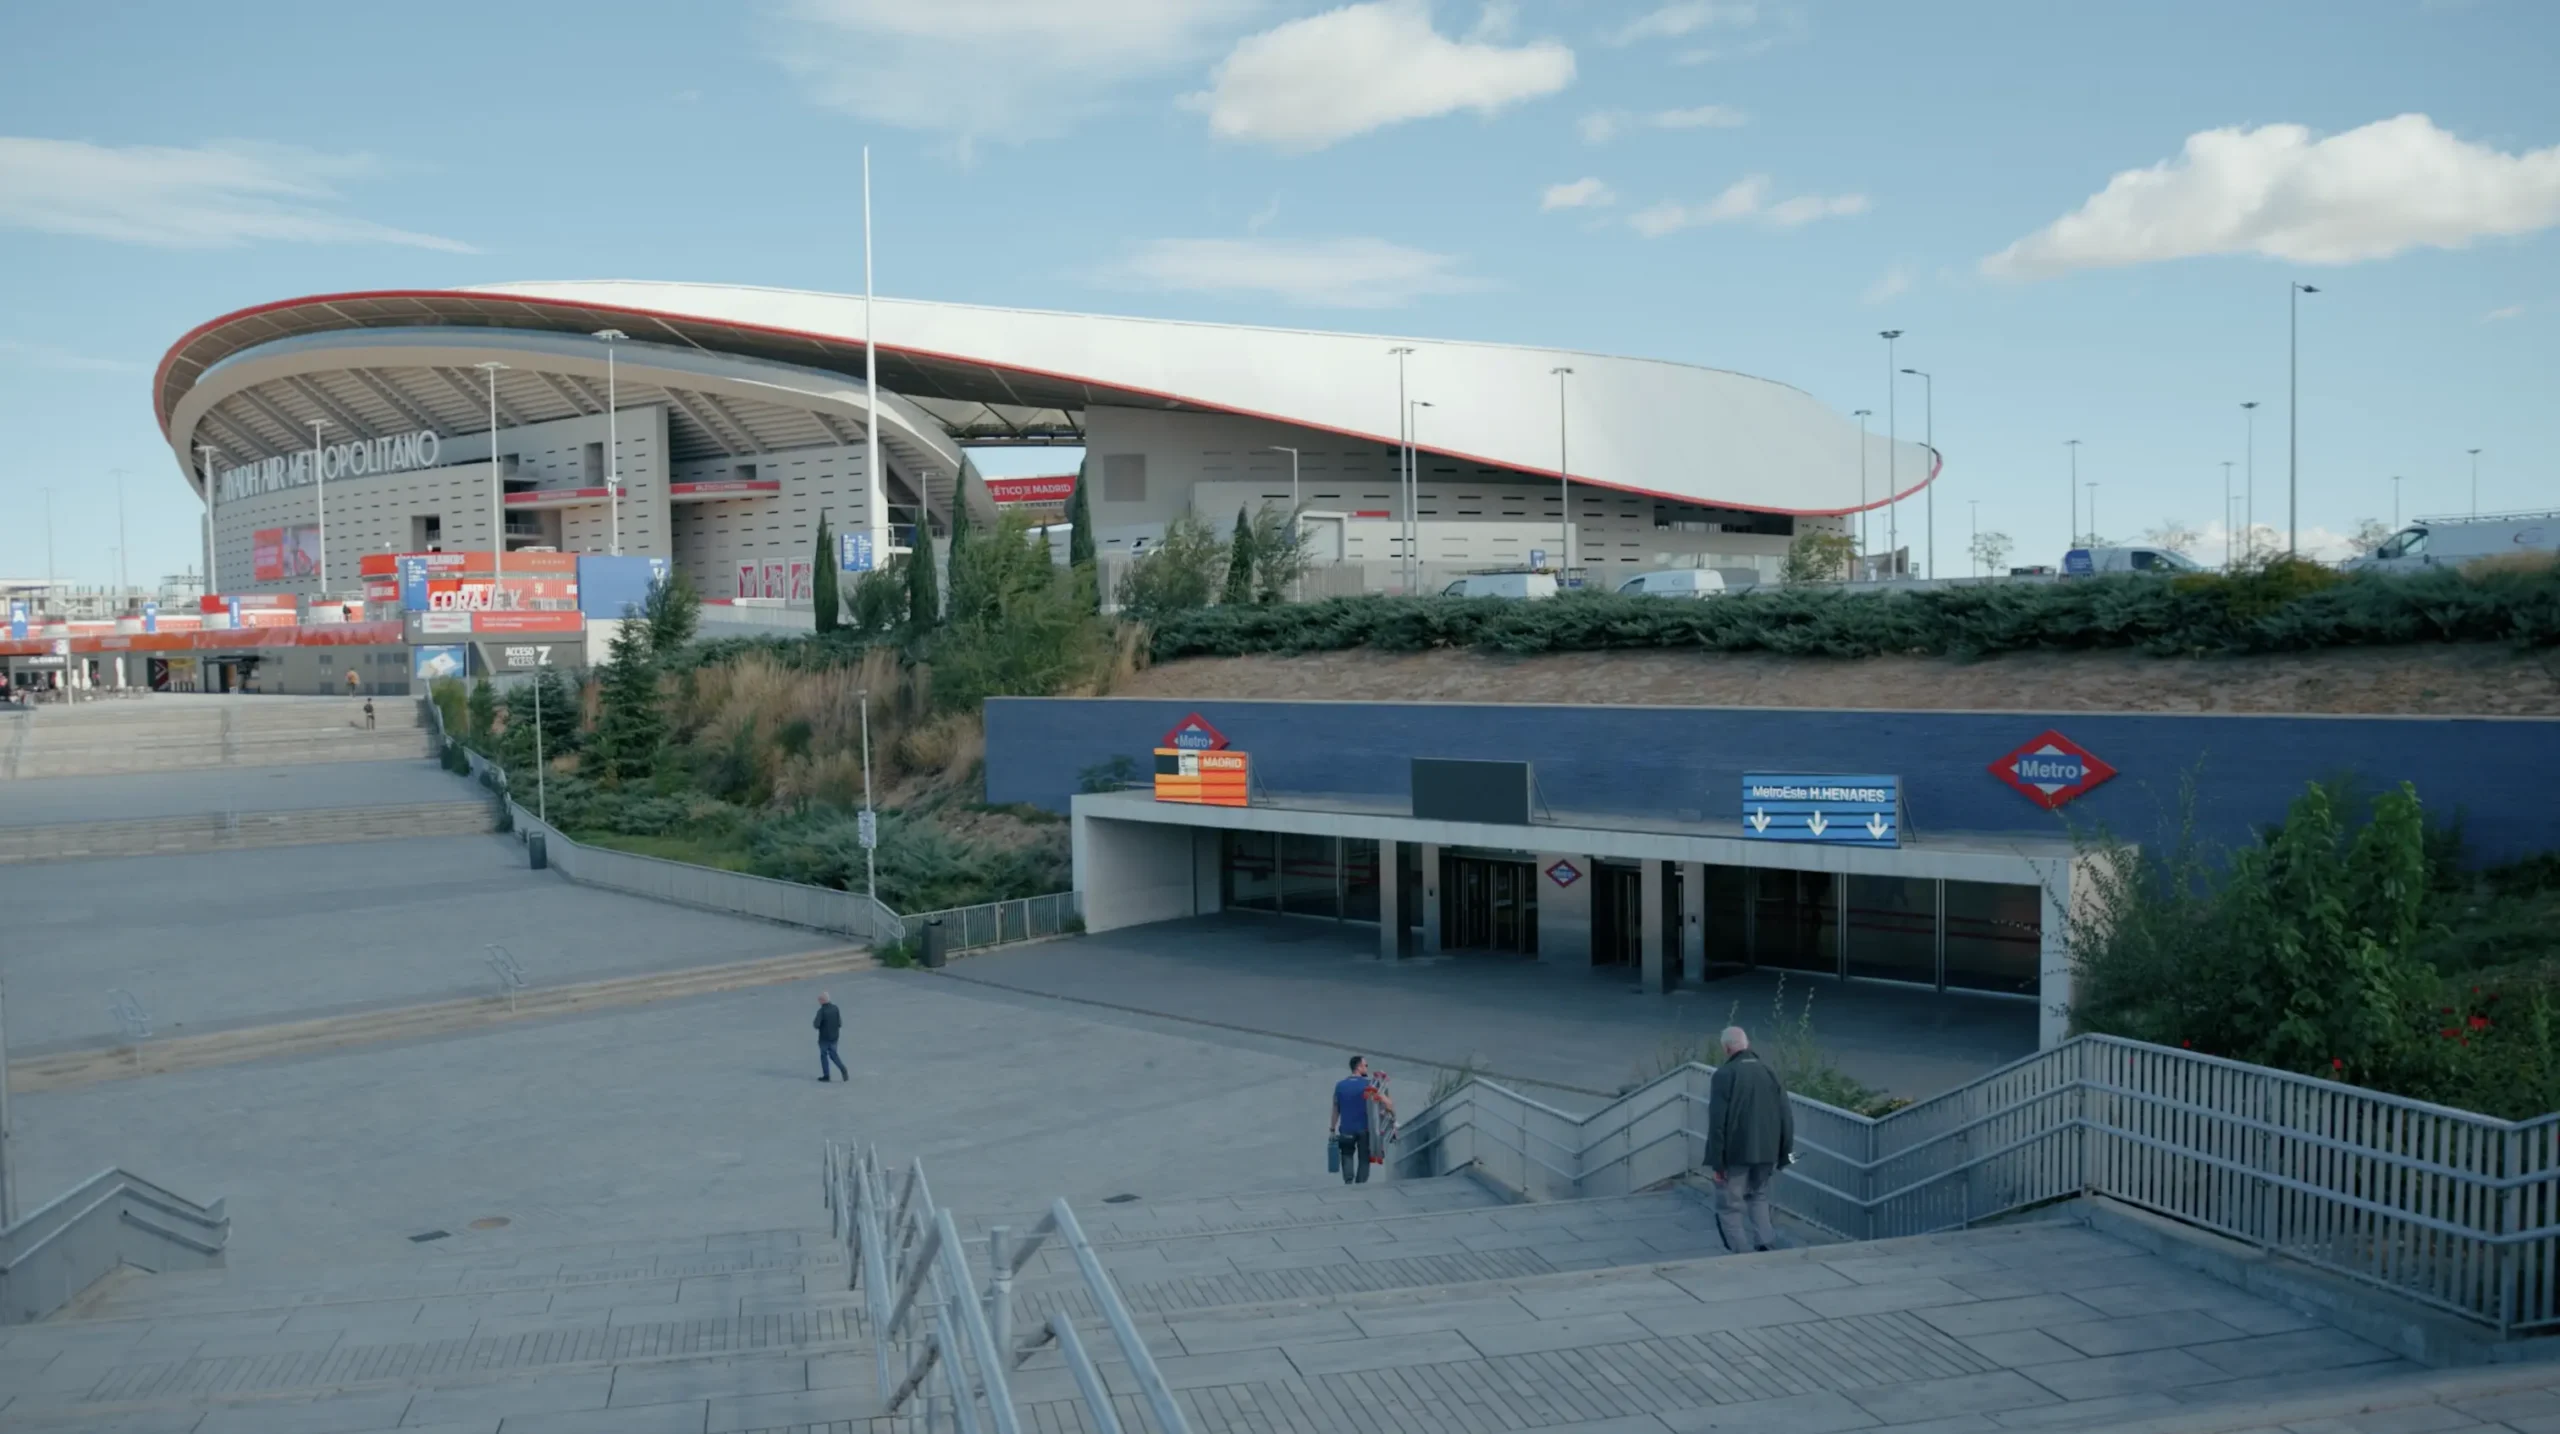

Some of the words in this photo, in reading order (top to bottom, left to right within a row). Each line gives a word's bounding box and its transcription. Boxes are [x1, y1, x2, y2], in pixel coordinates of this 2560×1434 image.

[1033, 484, 1071, 494] MADRID
[505, 646, 535, 657] ACCESO
[508, 656, 535, 667] ACCESS
[1179, 734, 1208, 748] Metro
[1203, 756, 1242, 769] MADRID
[2021, 760, 2078, 779] Metro
[1752, 785, 1807, 800] MetroEste
[1809, 787, 1886, 804] H.HENARES
